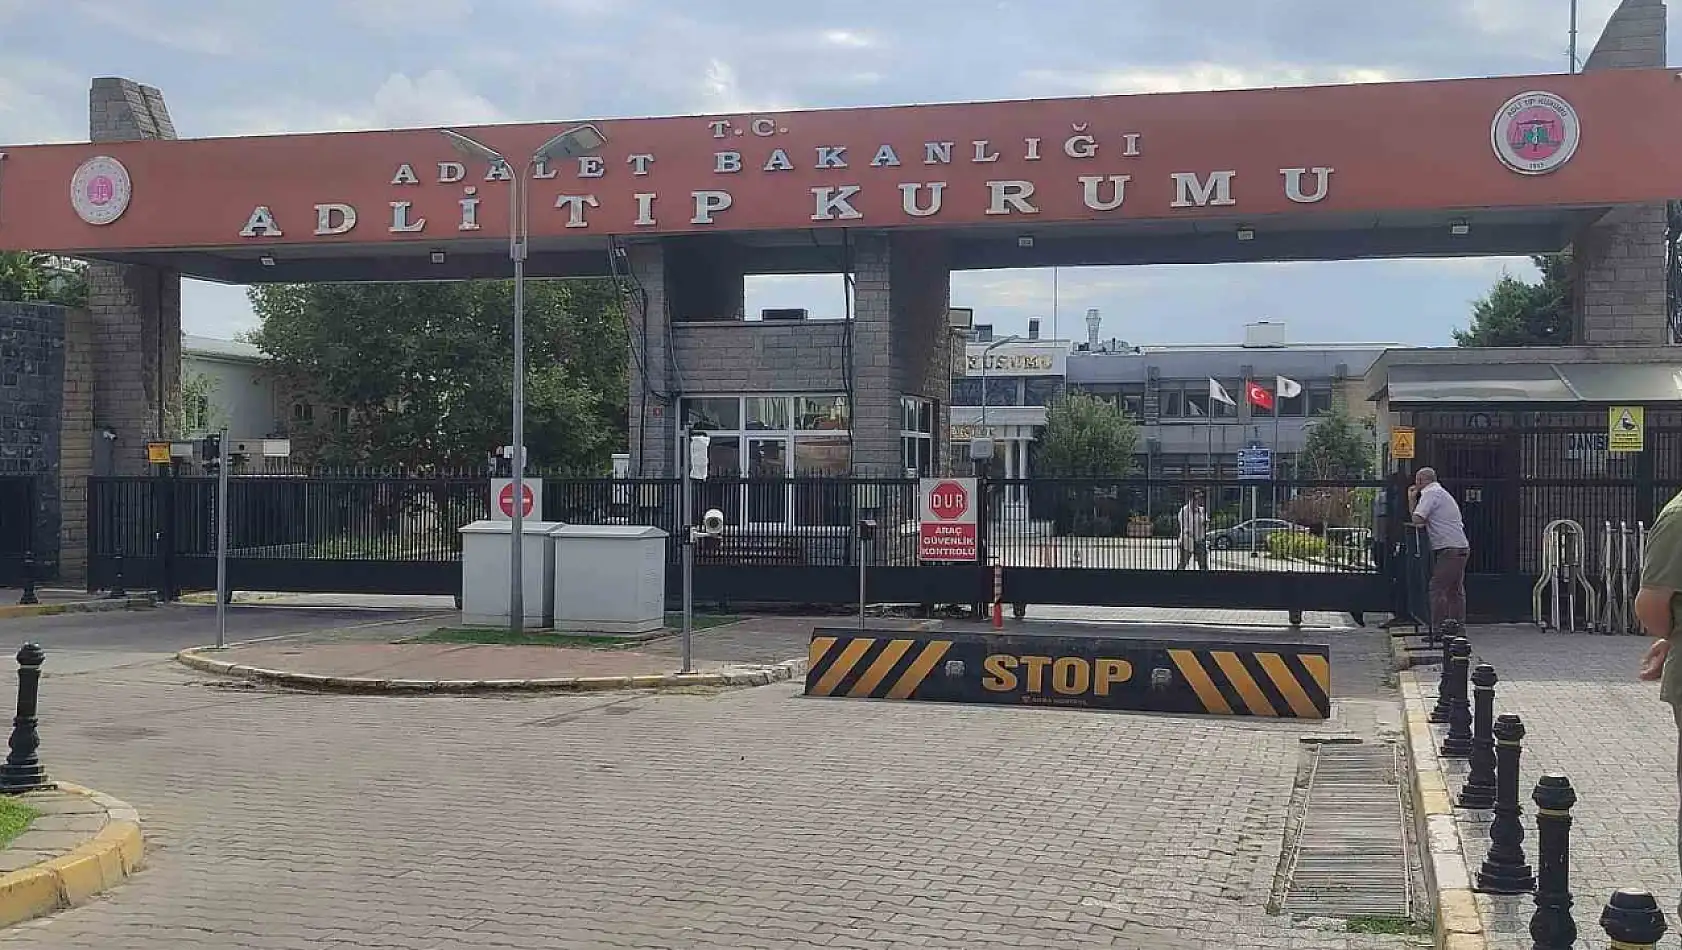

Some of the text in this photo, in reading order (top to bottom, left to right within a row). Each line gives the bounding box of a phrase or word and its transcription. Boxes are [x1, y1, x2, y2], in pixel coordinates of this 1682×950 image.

[709, 118, 790, 139] T.C.
[391, 123, 1143, 186] ADALET BAKANLIĞI
[239, 168, 1335, 237] ADLİ TIP KURUMU
[933, 494, 963, 508] DUR
[935, 527, 962, 536] ARAÇ
[983, 655, 1133, 695] STOP
